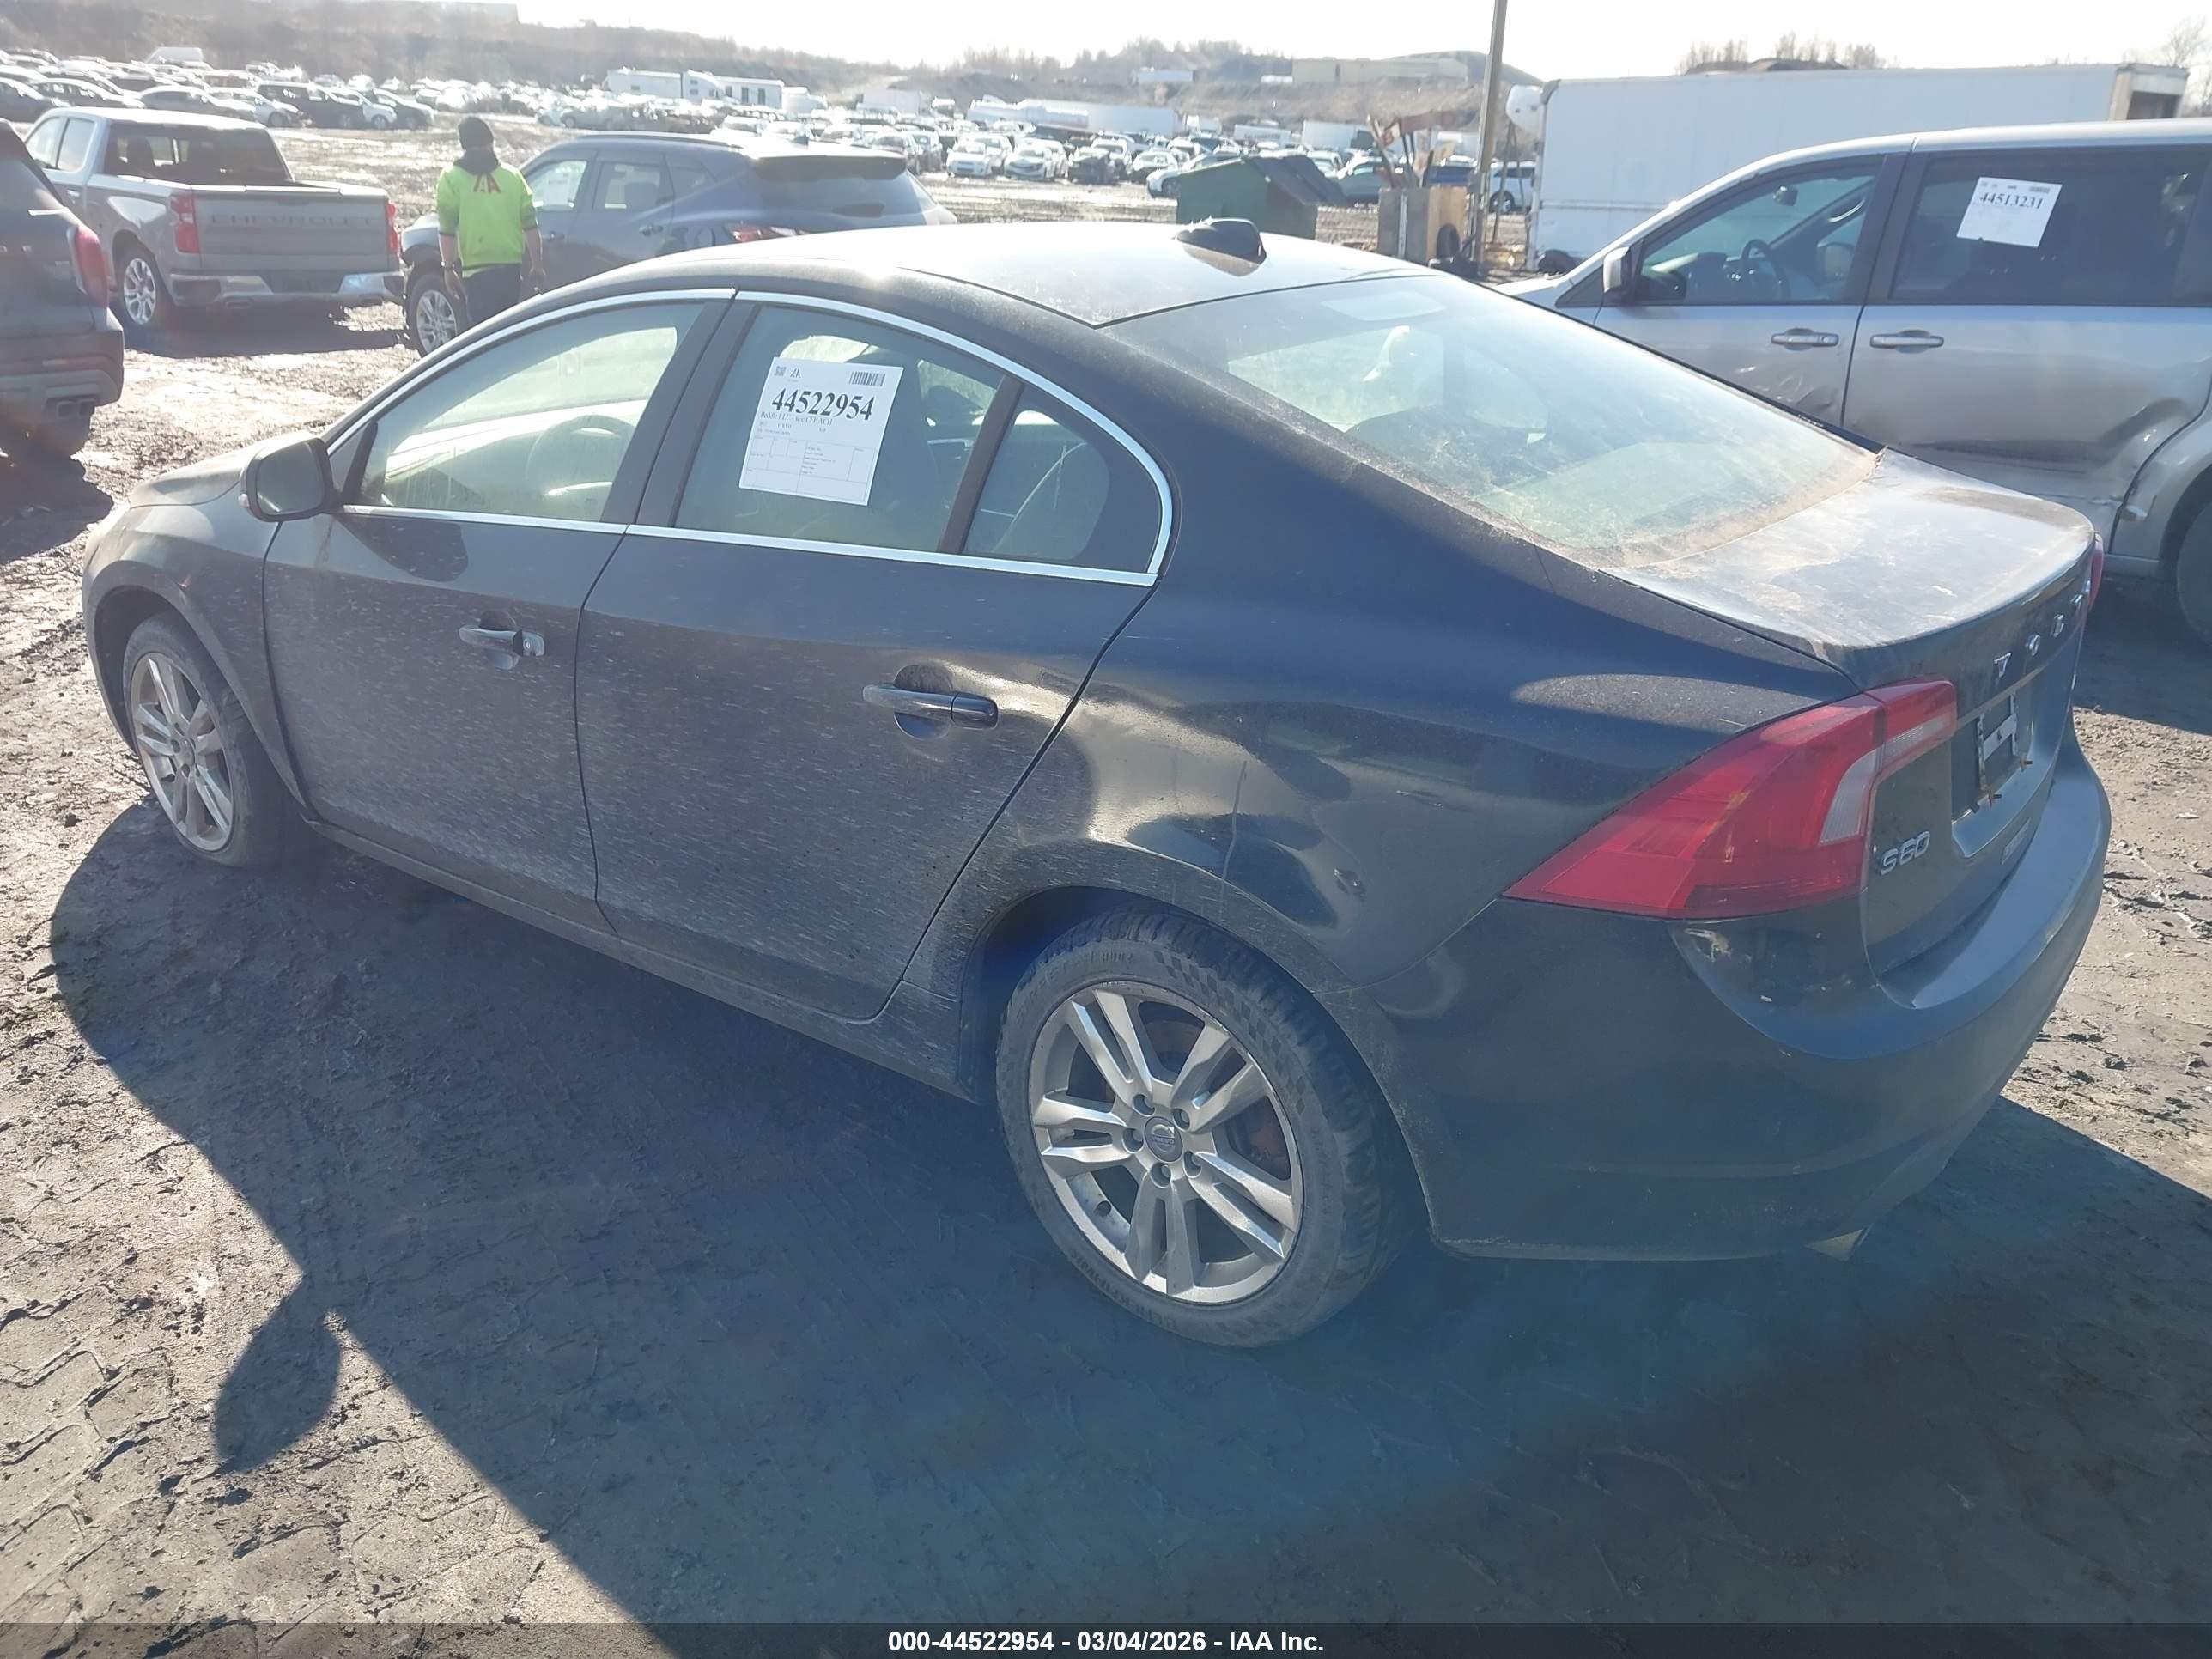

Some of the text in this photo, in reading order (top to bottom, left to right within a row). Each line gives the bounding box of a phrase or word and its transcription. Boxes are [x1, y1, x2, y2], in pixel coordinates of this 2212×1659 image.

[1979, 192, 2043, 209] 44513231
[211, 213, 373, 228] CHEVROLET
[772, 387, 875, 420] 44522954
[1881, 830, 1930, 875] S60
